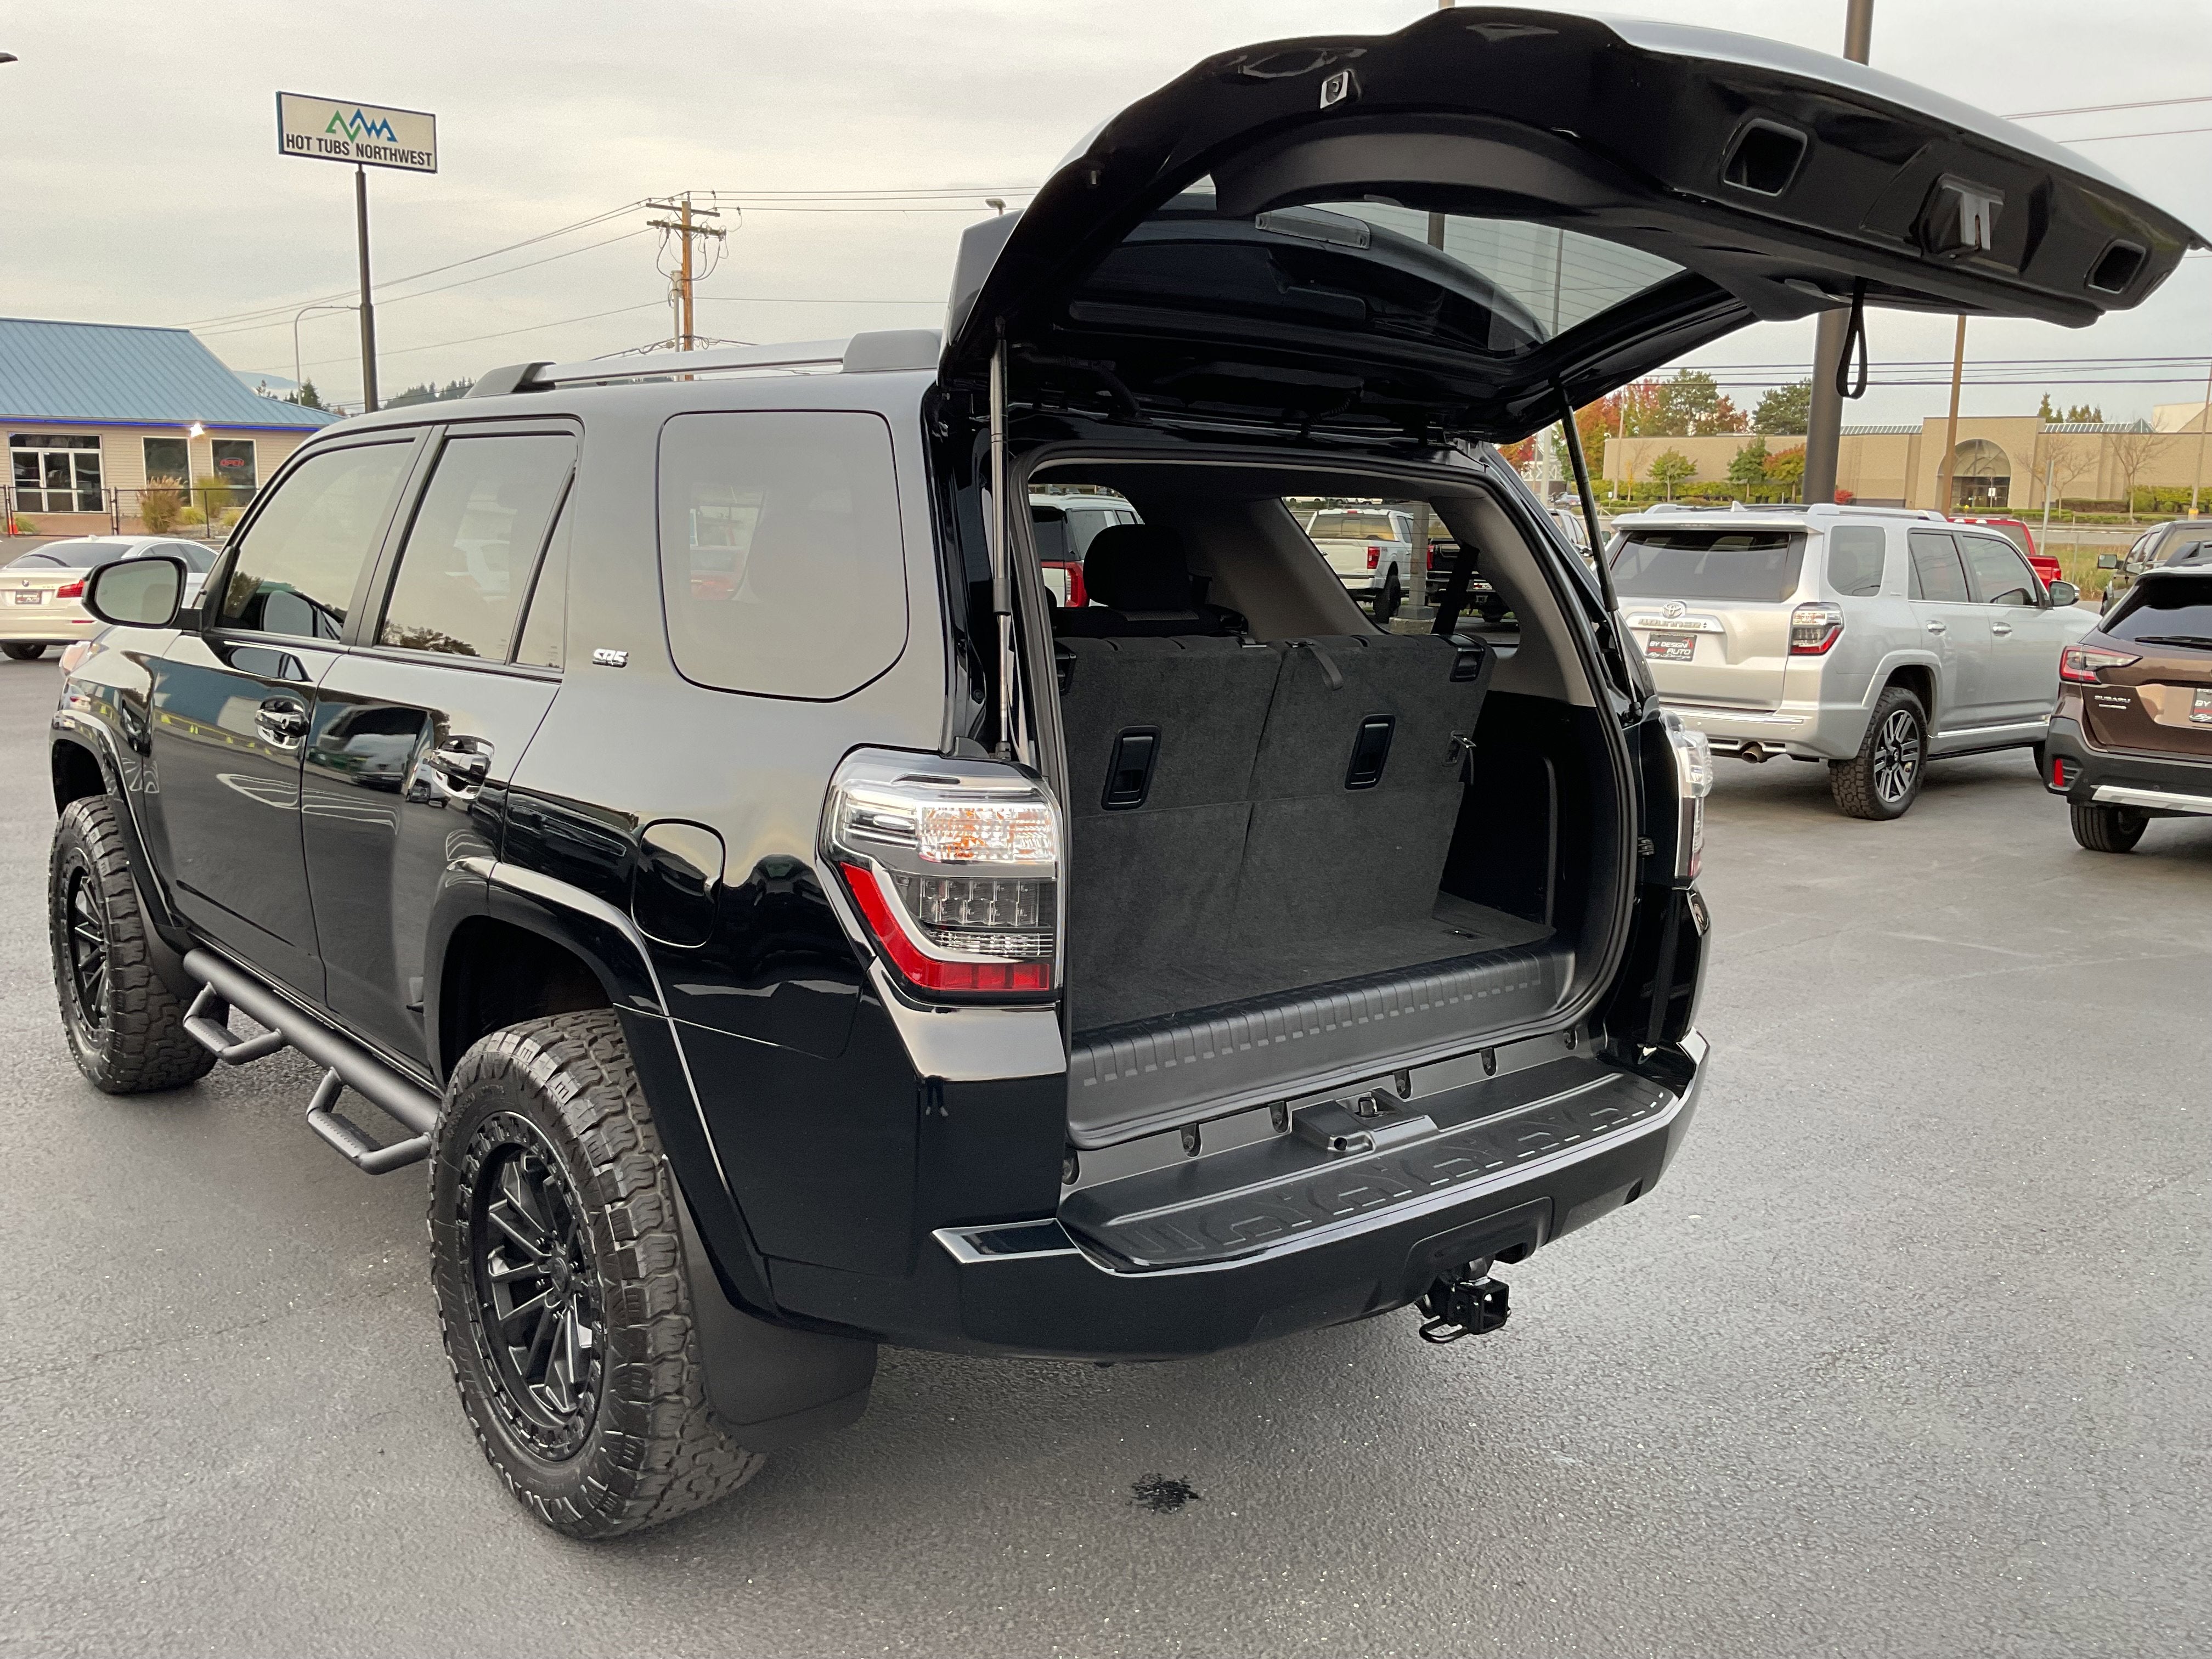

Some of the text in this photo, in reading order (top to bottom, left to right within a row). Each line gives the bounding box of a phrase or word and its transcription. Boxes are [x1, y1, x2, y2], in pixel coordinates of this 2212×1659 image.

[286, 133, 432, 166] HOT TUBS NORTHWEST
[592, 648, 628, 668] SR5
